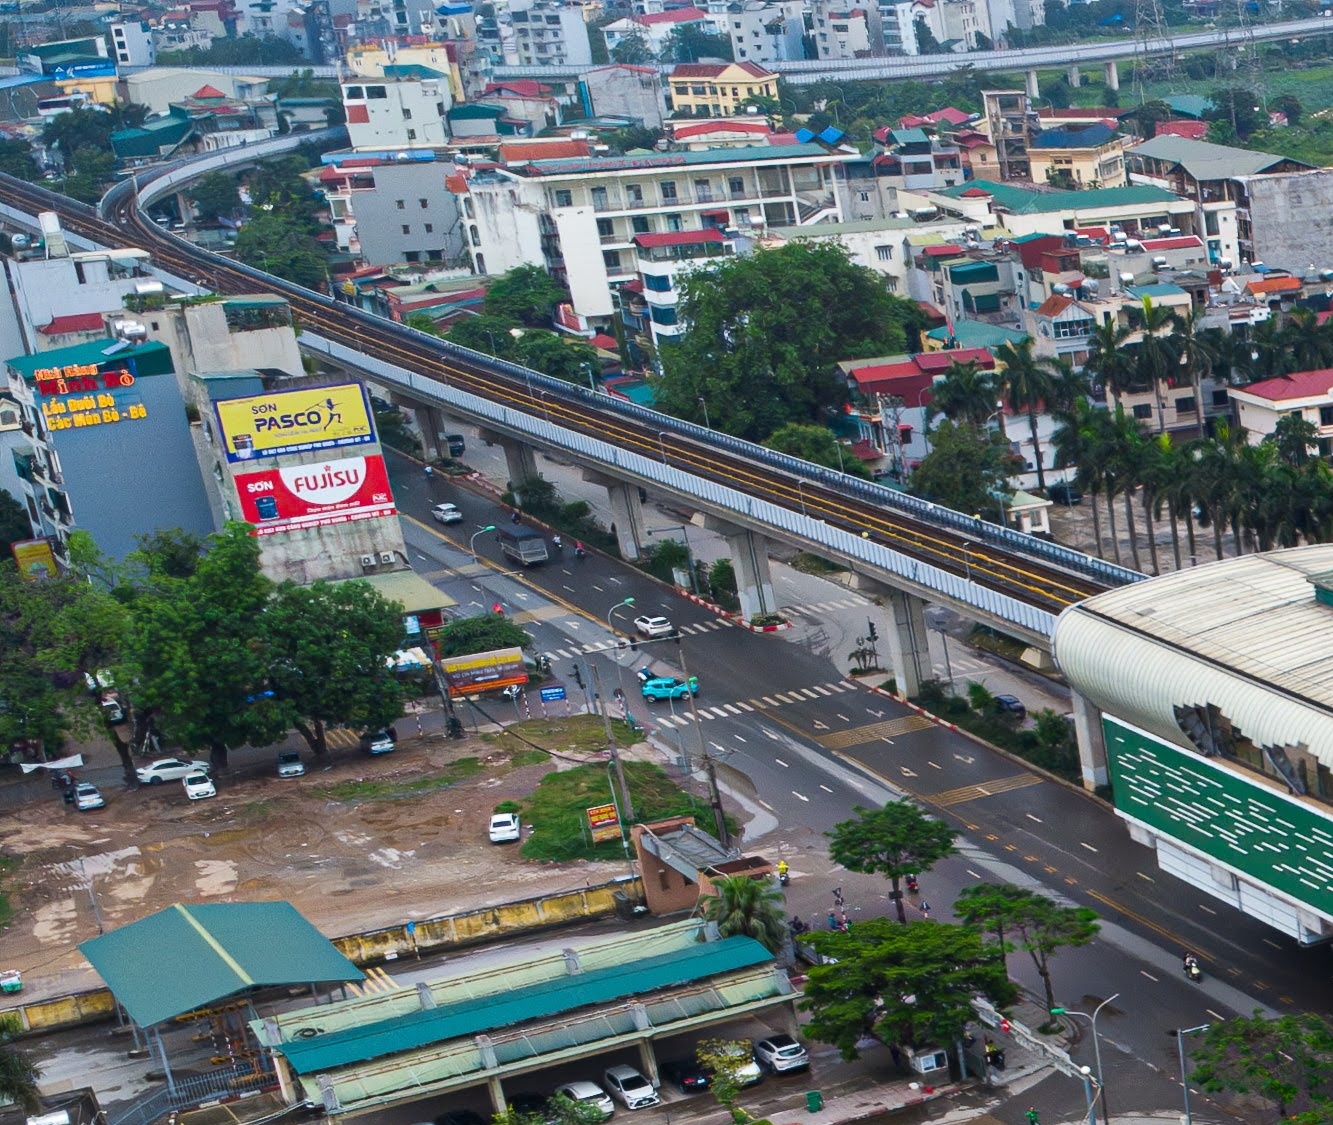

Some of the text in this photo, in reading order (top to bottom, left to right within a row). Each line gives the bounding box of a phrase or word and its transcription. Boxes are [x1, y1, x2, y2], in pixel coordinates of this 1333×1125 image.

[251, 403, 277, 415] SƠN
[254, 410, 322, 432] PASCO
[247, 480, 274, 493] SƠN
[294, 469, 359, 493] FUJISU
